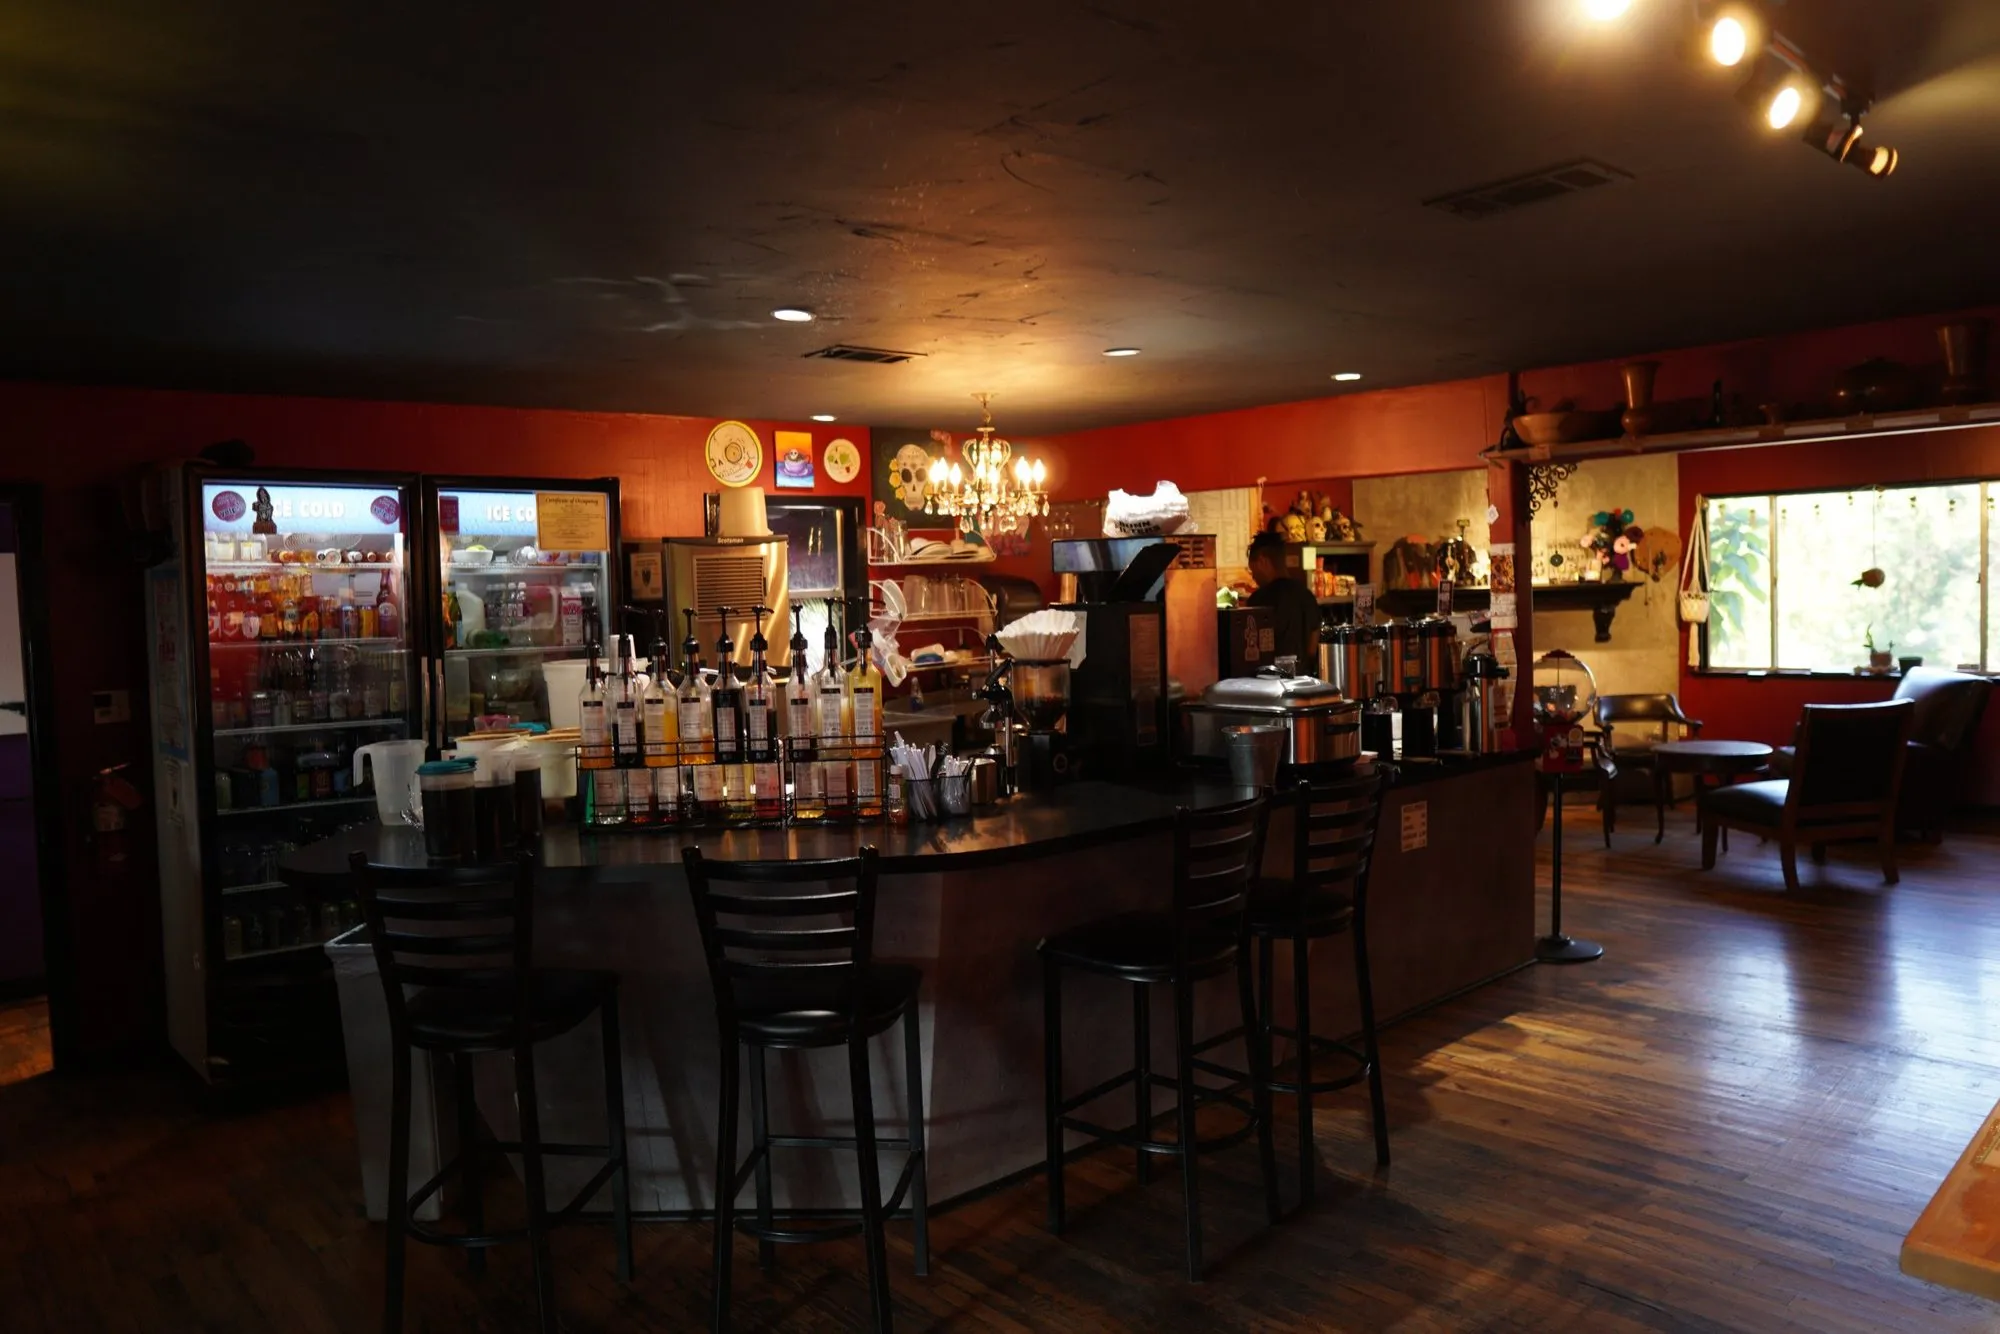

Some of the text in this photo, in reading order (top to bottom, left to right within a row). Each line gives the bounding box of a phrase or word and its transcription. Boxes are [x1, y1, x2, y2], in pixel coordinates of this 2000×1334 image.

[271, 501, 345, 518] CE COLD
[487, 505, 537, 521] ICE CO
